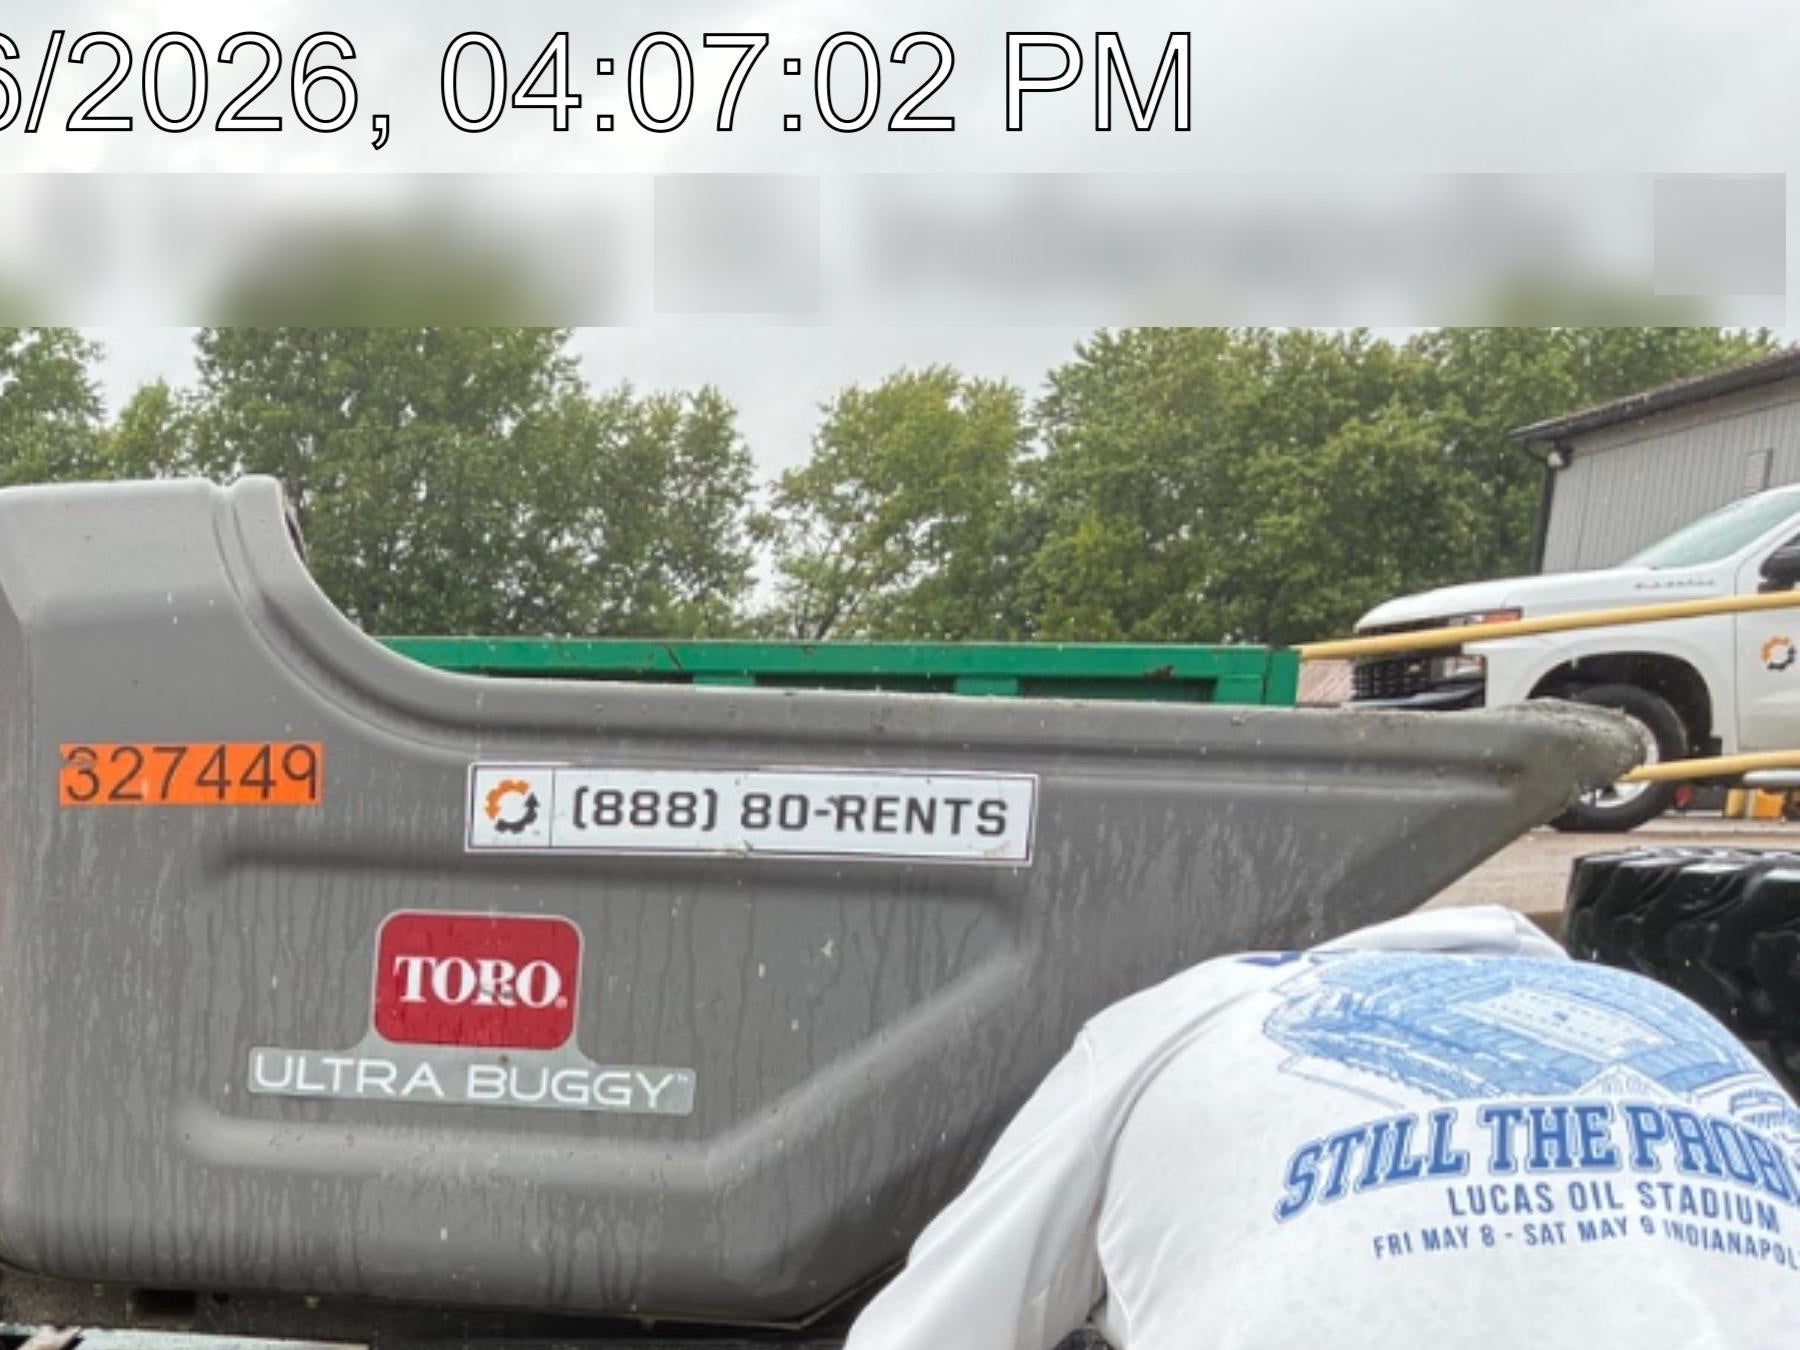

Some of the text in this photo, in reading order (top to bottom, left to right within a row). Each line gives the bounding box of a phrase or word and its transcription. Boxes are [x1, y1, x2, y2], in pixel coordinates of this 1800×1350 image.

[65, 742, 318, 801] 327449
[572, 785, 1008, 837] (888) 80-RENTS
[392, 955, 564, 1009] TORO
[253, 1053, 446, 1098] ULTRA
[1276, 1102, 1800, 1222] STILL THE PROB
[1446, 1180, 1780, 1233] LUCAS OIL STADIUM
[1372, 1232, 1414, 1259] FRI
[1421, 1225, 1470, 1250] MAY
[1479, 1223, 1496, 1248] 8
[1522, 1220, 1567, 1246] SAT
[1577, 1215, 1628, 1243] MAY
[1663, 1219, 1800, 1271] INDIANAPOL
